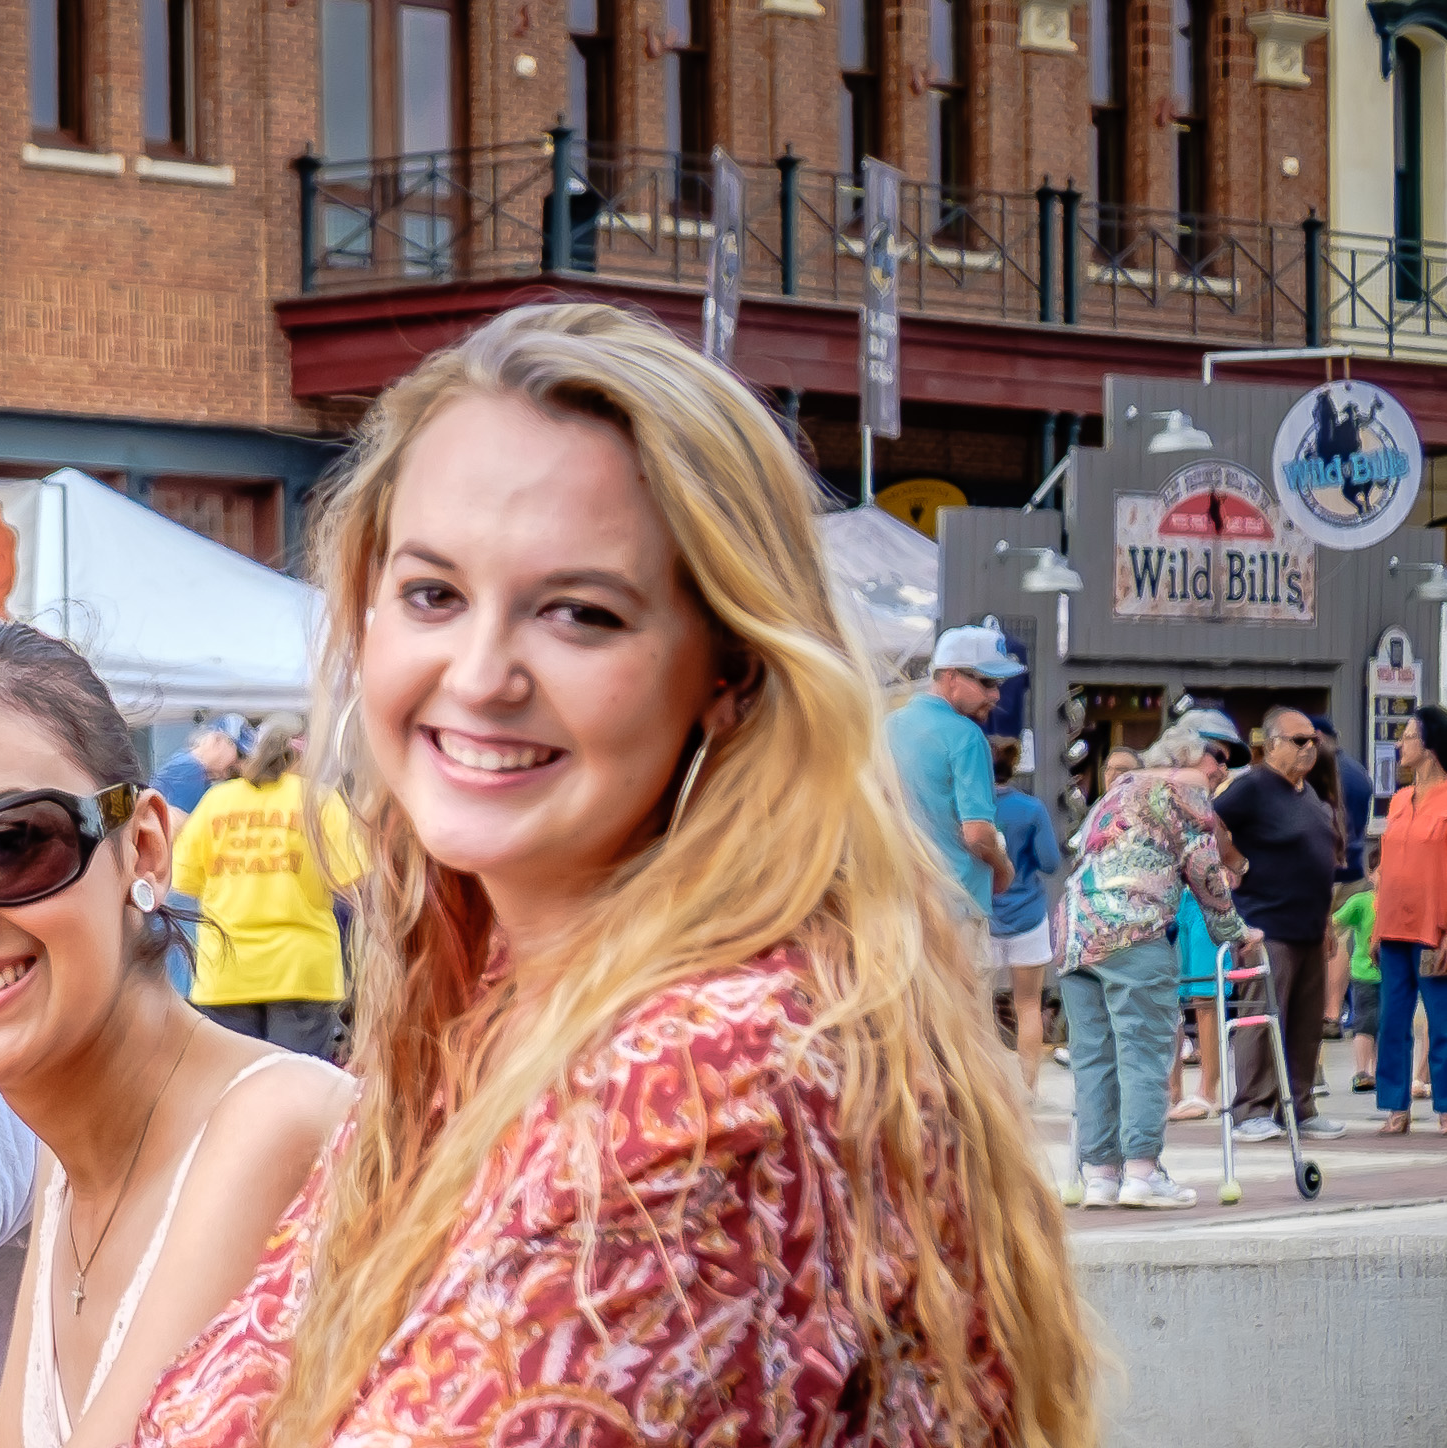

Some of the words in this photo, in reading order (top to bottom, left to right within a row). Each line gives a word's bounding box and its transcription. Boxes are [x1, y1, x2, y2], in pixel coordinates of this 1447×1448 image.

[1282, 453, 1344, 492] Wild
[1128, 546, 1214, 600] Wild
[1225, 549, 1306, 612] Bill's
